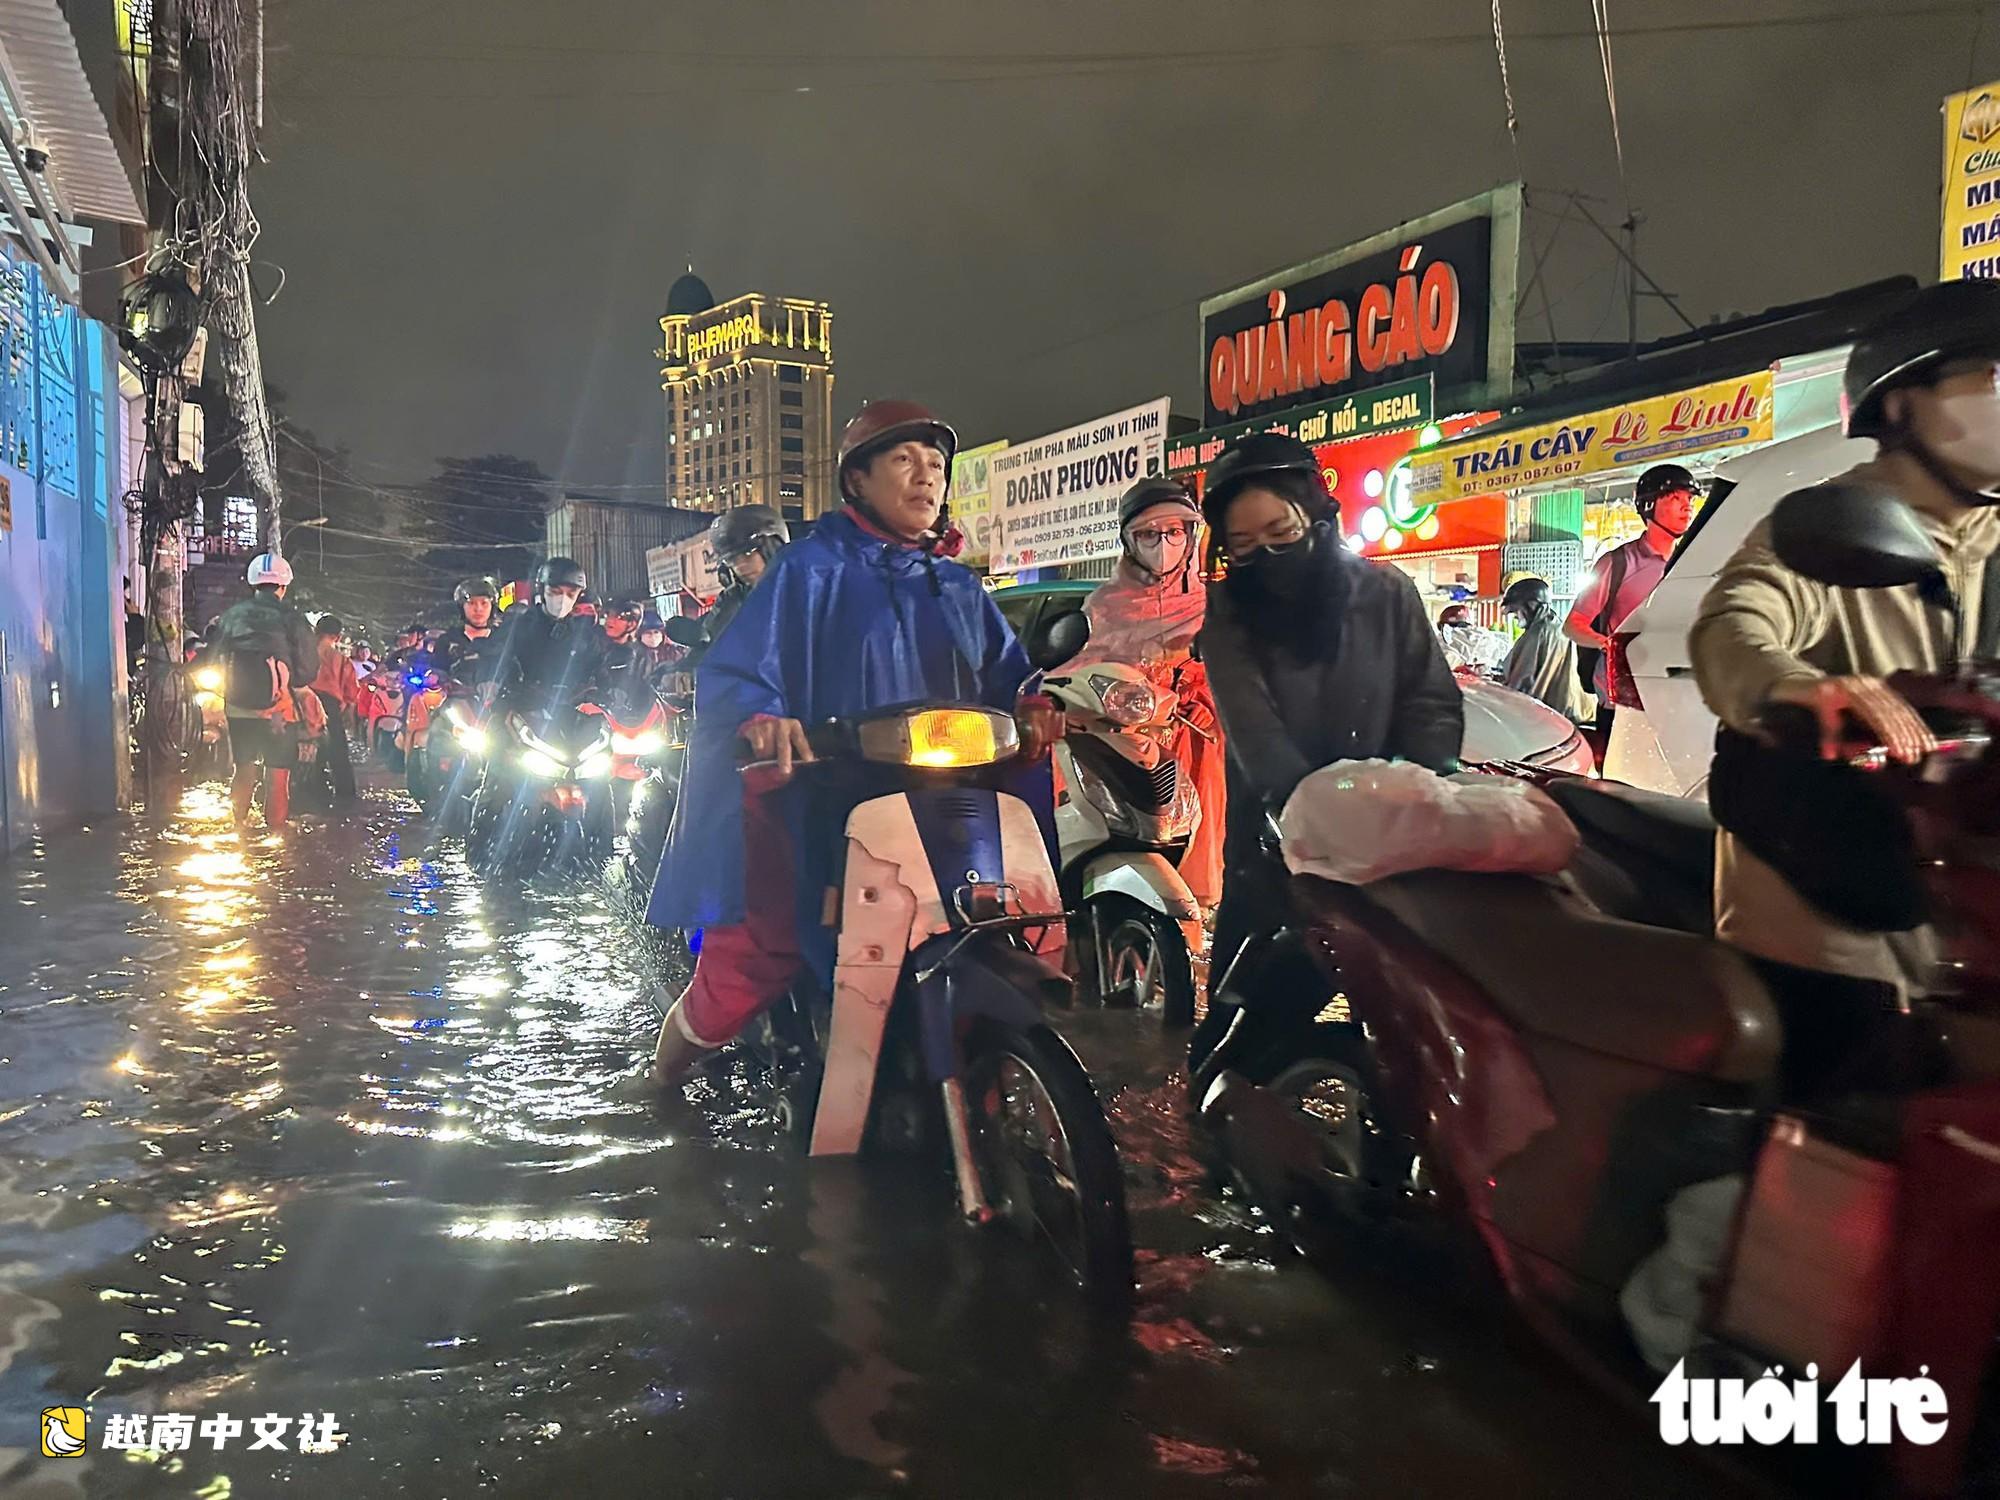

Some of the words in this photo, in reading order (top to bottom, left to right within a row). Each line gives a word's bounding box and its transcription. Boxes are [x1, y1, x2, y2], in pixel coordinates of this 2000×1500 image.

[1209, 289, 1351, 416] QUẢNG
[1357, 245, 1460, 373] CÁO
[994, 452, 1021, 473] TRUNG
[1045, 440, 1064, 459] PHA
[1067, 432, 1089, 453] MÀU
[1093, 425, 1115, 445] SƠN
[1118, 421, 1129, 437] VI
[1132, 411, 1158, 433] TÍNH
[1168, 441, 1196, 470] BẢNG
[1299, 410, 1327, 443] CHỮ
[1333, 398, 1357, 435] NỔI
[1373, 393, 1420, 426] DECAL
[1452, 440, 1523, 478] TRÁI
[1530, 426, 1596, 461] CÂY
[1601, 412, 1649, 450] Lê
[1658, 384, 1758, 438] Linh
[1006, 466, 1052, 508] ĐOÀN
[1057, 445, 1138, 495] PHƯƠNG
[1463, 481, 1482, 493] ĐT:
[1487, 461, 1581, 488] 0367.087.607
